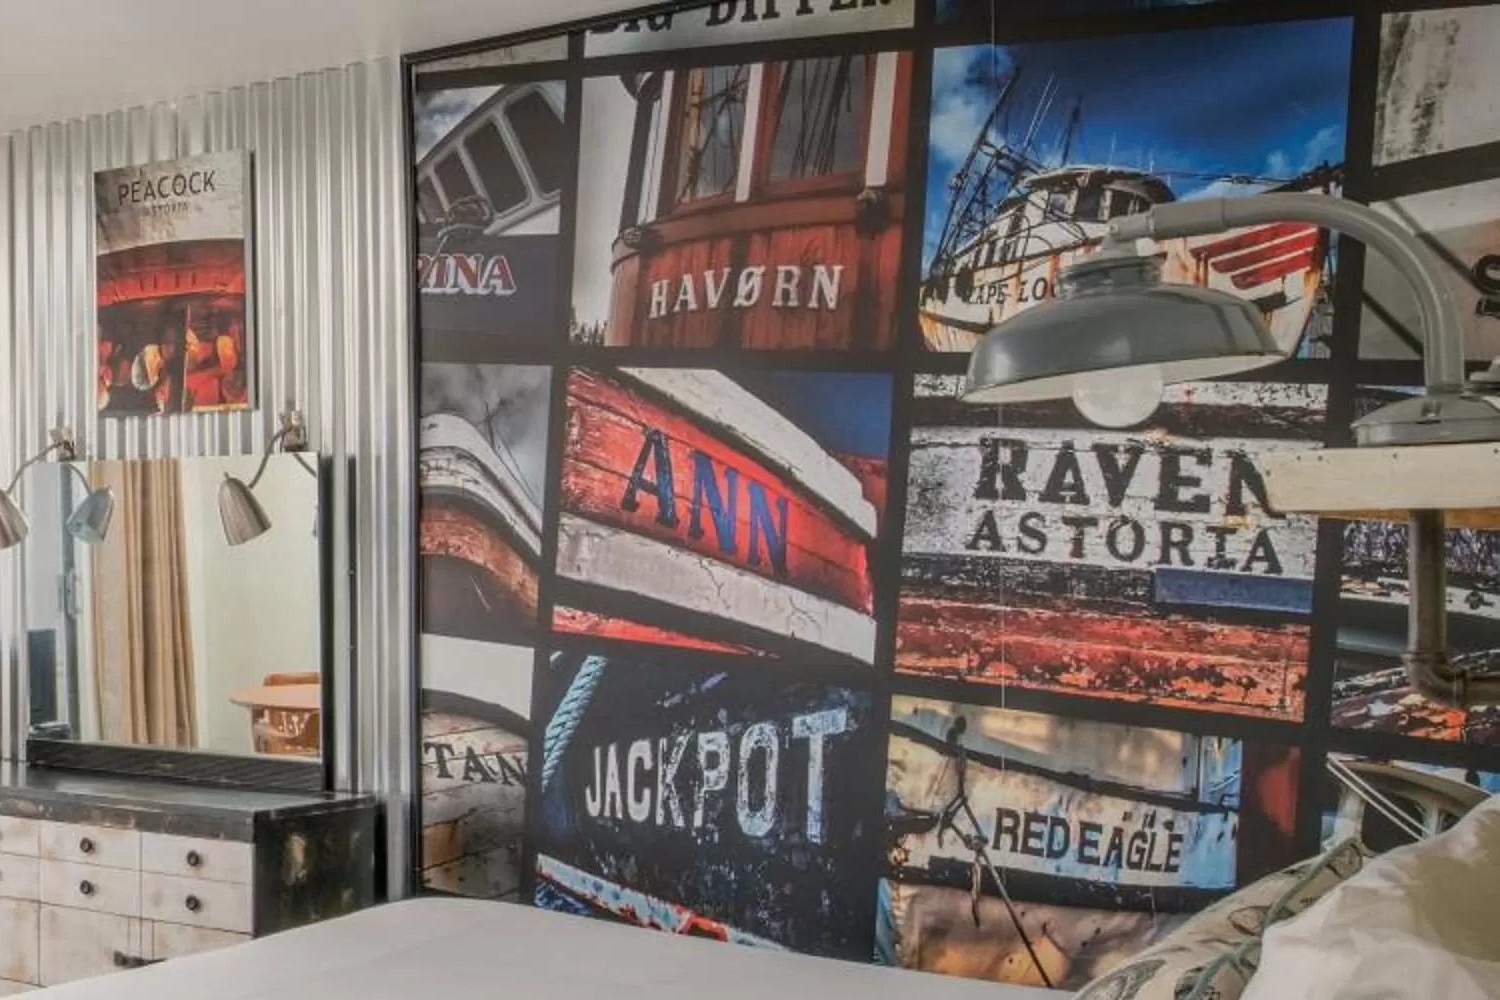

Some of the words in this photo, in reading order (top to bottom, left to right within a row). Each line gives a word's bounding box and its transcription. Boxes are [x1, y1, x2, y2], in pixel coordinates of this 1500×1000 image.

[118, 169, 216, 206] PEACOCK
[649, 265, 844, 319] HAVØRN
[620, 429, 788, 580] ANN
[975, 438, 1287, 519] RAVEN
[965, 510, 1284, 575] ASTORIA
[585, 708, 847, 844] JACKPOT
[992, 807, 1070, 859] RED
[1077, 820, 1184, 872] EAGLE
